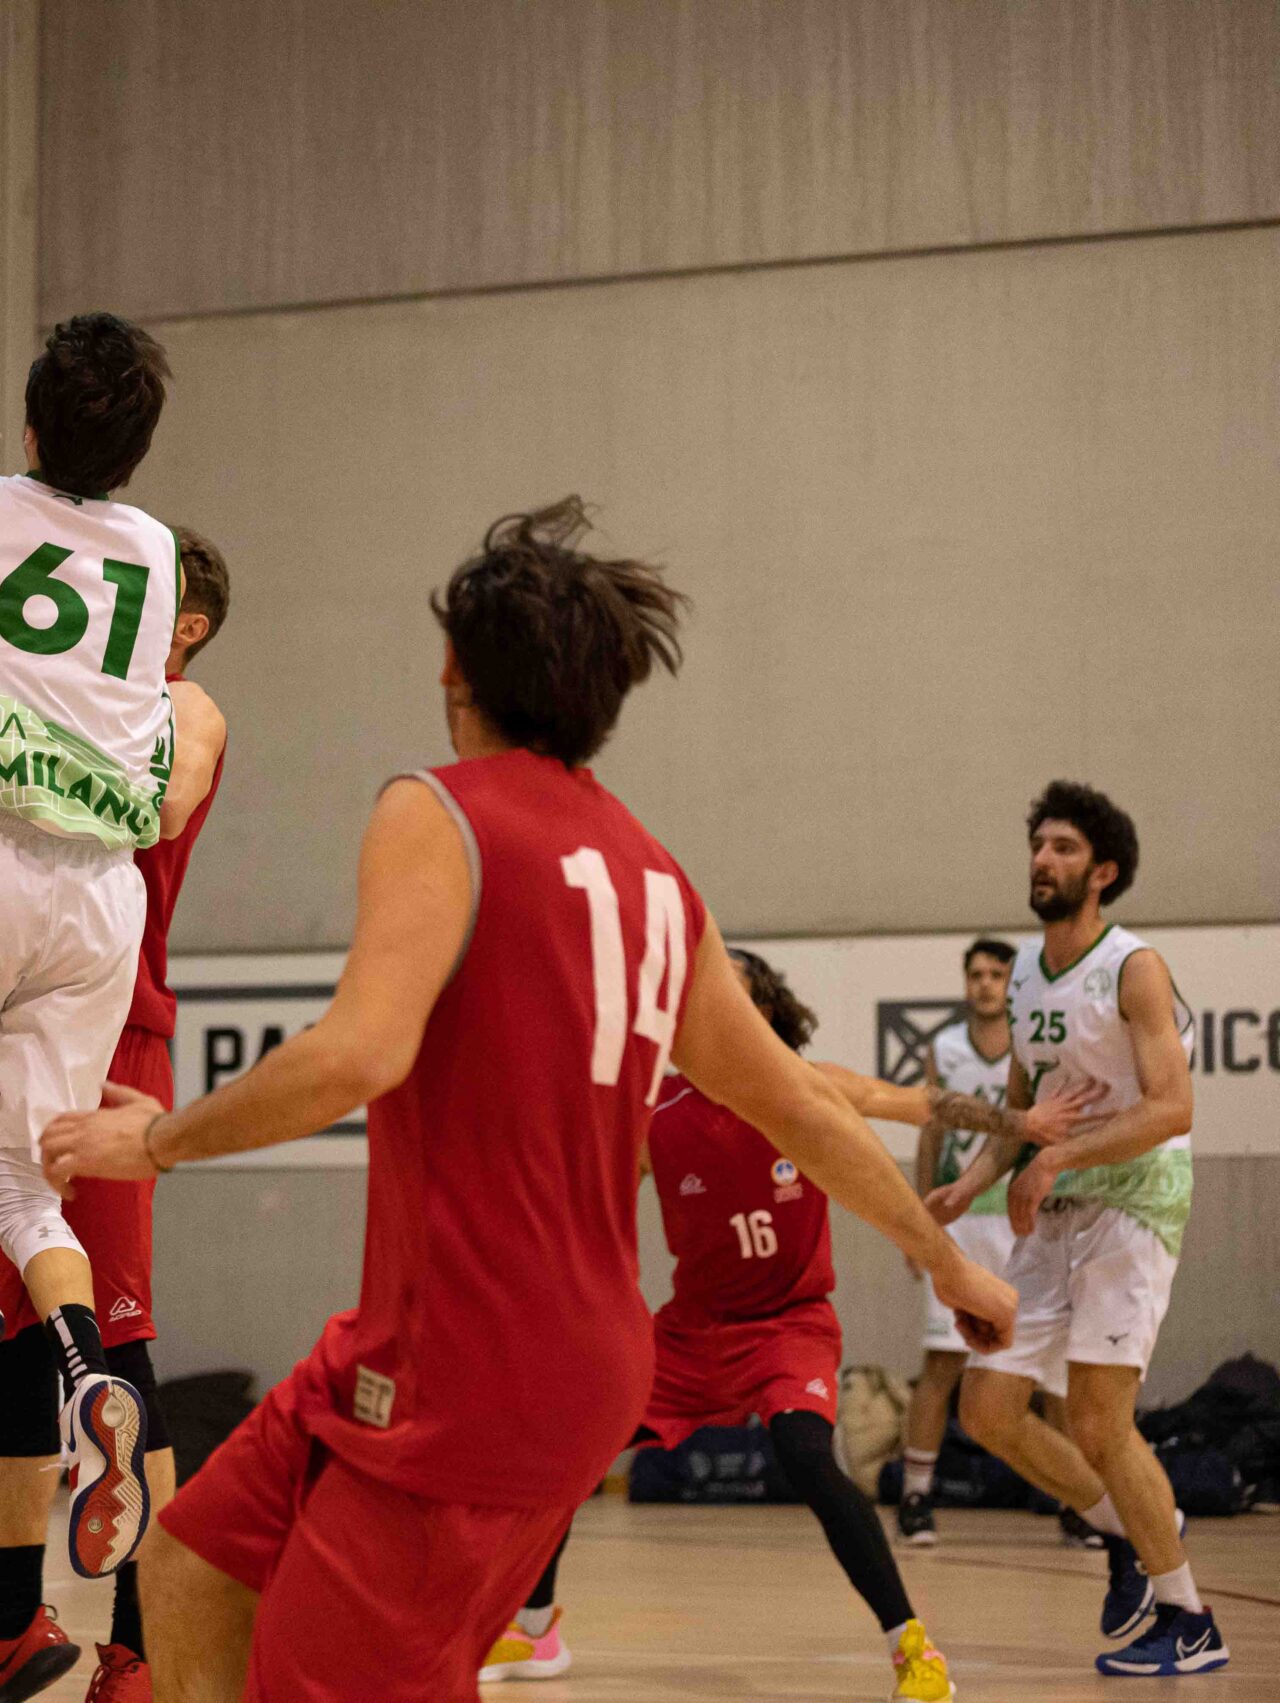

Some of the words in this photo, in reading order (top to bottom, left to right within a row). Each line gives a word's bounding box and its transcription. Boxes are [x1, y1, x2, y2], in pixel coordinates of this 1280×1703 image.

[560, 845, 688, 1108] 14
[1029, 1010, 1068, 1045] 25
[729, 1209, 779, 1260] 16
